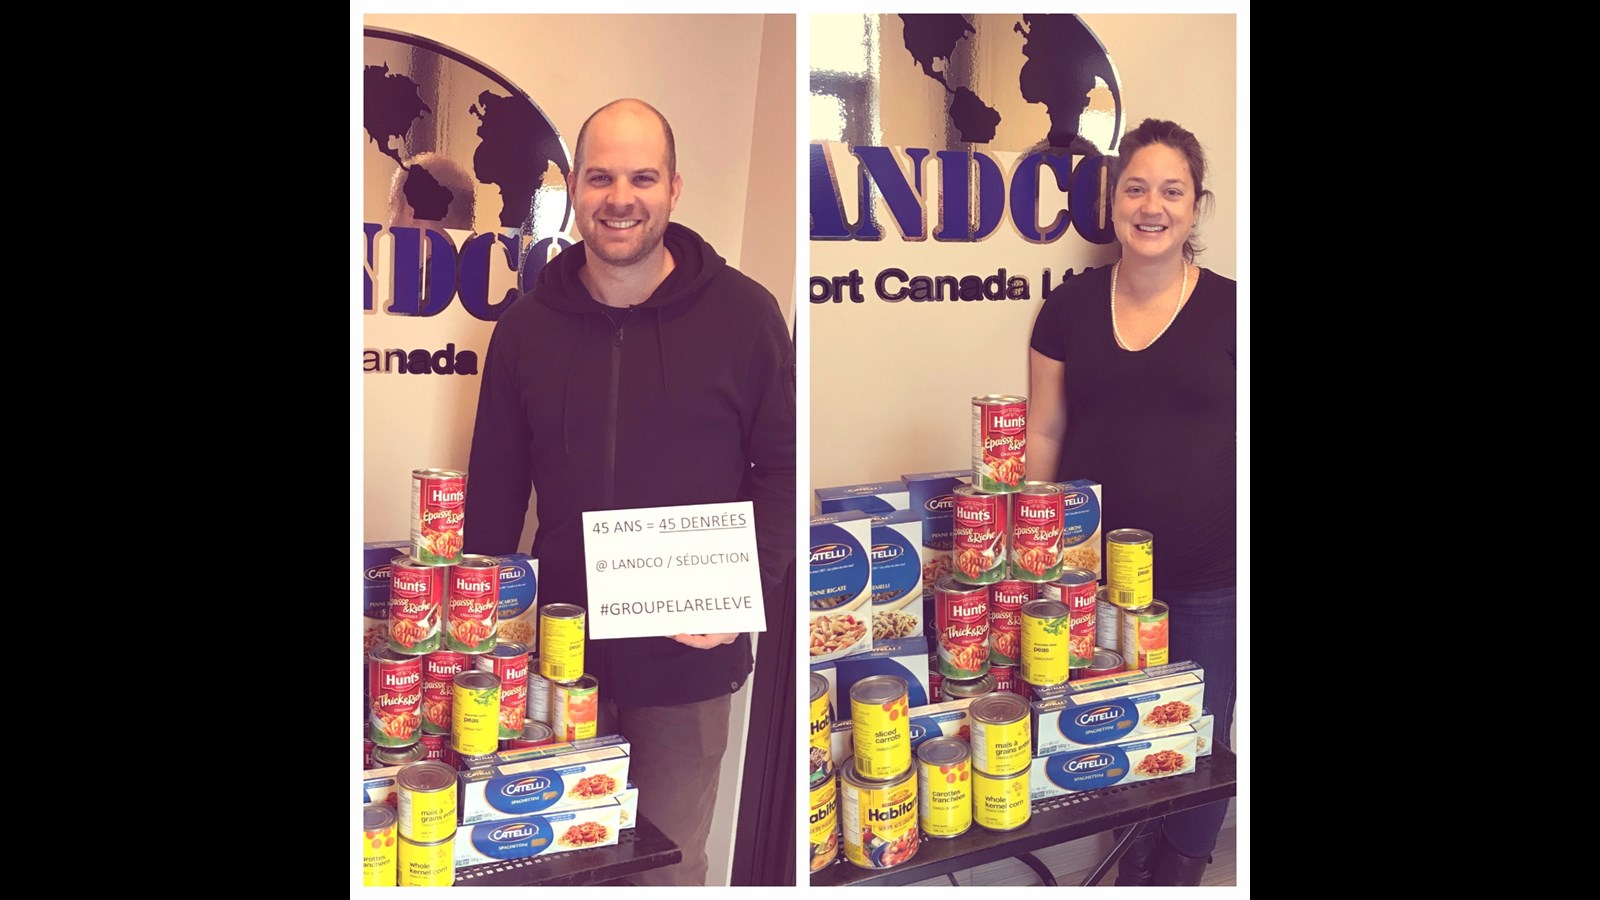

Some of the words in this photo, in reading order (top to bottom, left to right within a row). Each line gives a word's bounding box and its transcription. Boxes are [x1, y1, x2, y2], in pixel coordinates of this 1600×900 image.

[874, 267, 1030, 302] Canada
[993, 415, 1026, 428] Hunt's
[433, 489, 464, 503] Hunt's
[956, 505, 990, 521] Hunt's
[1020, 505, 1056, 519] Hunt's
[592, 521, 610, 535] 45
[614, 519, 643, 533] ANS
[658, 518, 676, 531] 45
[681, 512, 747, 530] DENRÉES
[596, 559, 608, 572] @
[612, 556, 663, 571] LANDCO
[667, 555, 673, 569] /
[676, 552, 750, 567] SÉDUCTION
[393, 576, 427, 593] Hunt's
[456, 577, 491, 592] Hunt's
[994, 591, 1029, 604] Hunt's
[600, 595, 753, 616] #GROUPELARELEVE
[953, 602, 987, 617] Hunt's
[428, 661, 462, 675] Hunt's
[386, 670, 420, 686] Hunt's
[1080, 710, 1119, 725] CATELLI
[875, 728, 897, 738] sliced
[875, 733, 901, 744] carrots
[995, 748, 1018, 757] grains
[1068, 757, 1108, 771] CATELLI
[506, 781, 545, 795] CATELLI
[932, 789, 961, 797] carottes
[985, 795, 1007, 803] whole
[985, 801, 1008, 810] kernel
[1008, 799, 1024, 809] corn
[420, 815, 443, 824] grains
[493, 827, 533, 841] CATELLI
[409, 861, 431, 869] whole
[409, 867, 432, 876] kernel
